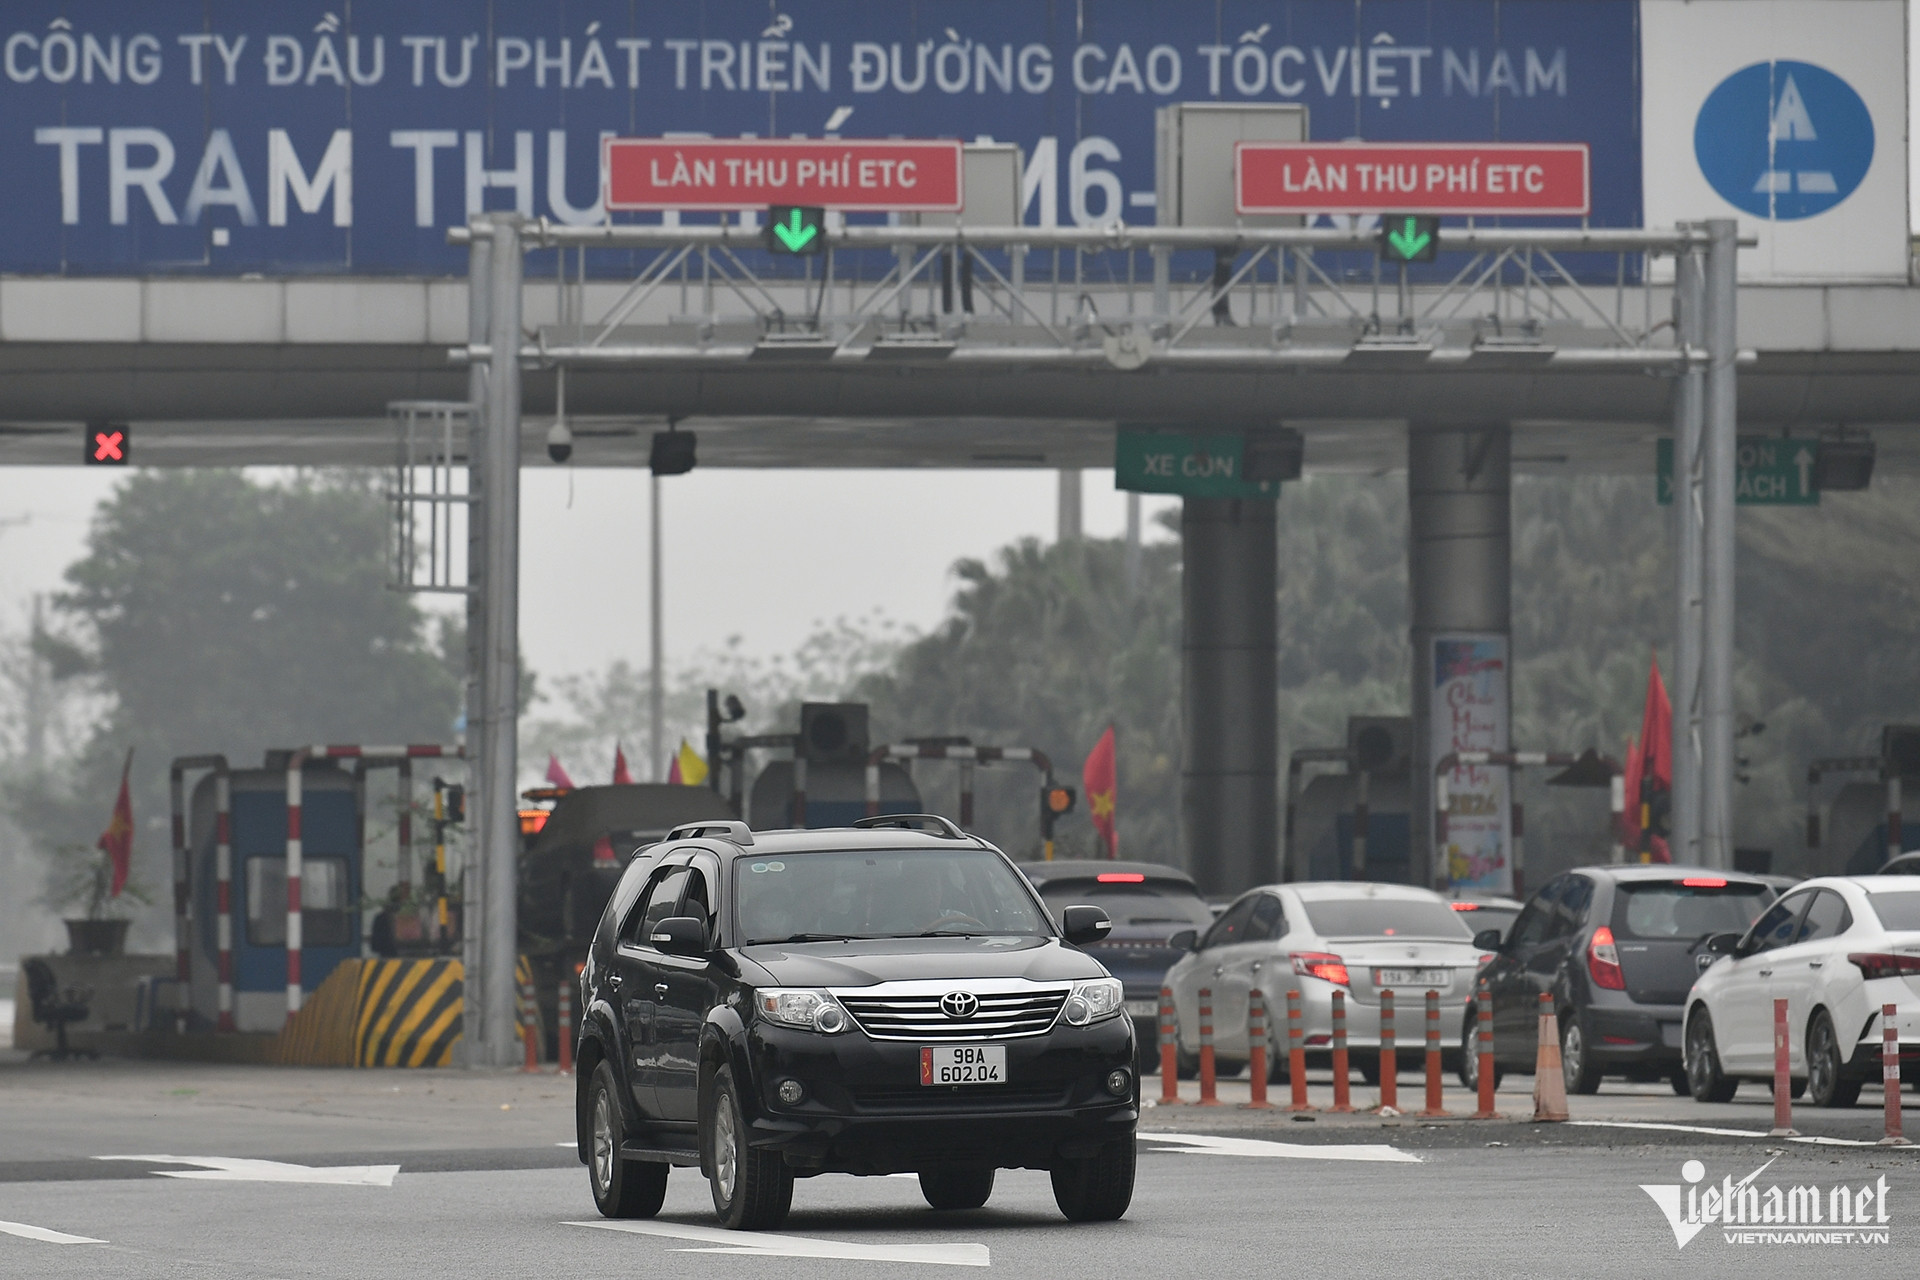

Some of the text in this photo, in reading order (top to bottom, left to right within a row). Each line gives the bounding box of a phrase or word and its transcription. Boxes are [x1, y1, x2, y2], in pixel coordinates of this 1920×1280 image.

[4, 13, 1566, 108] CÔNG TY ĐẦU TƯ PHÁT TRIỂN ĐƯỜNG CAO TỐC VIỆT NAM
[35, 127, 352, 246] TRẠM
[391, 130, 616, 227] THU
[650, 151, 917, 188] LÀN THU PHÍ ETC
[1283, 156, 1545, 193] LÀN THU PHÍ ETC
[1143, 454, 1174, 476] XE
[941, 1066, 998, 1082] 602.04
[954, 1048, 985, 1064] 98A
